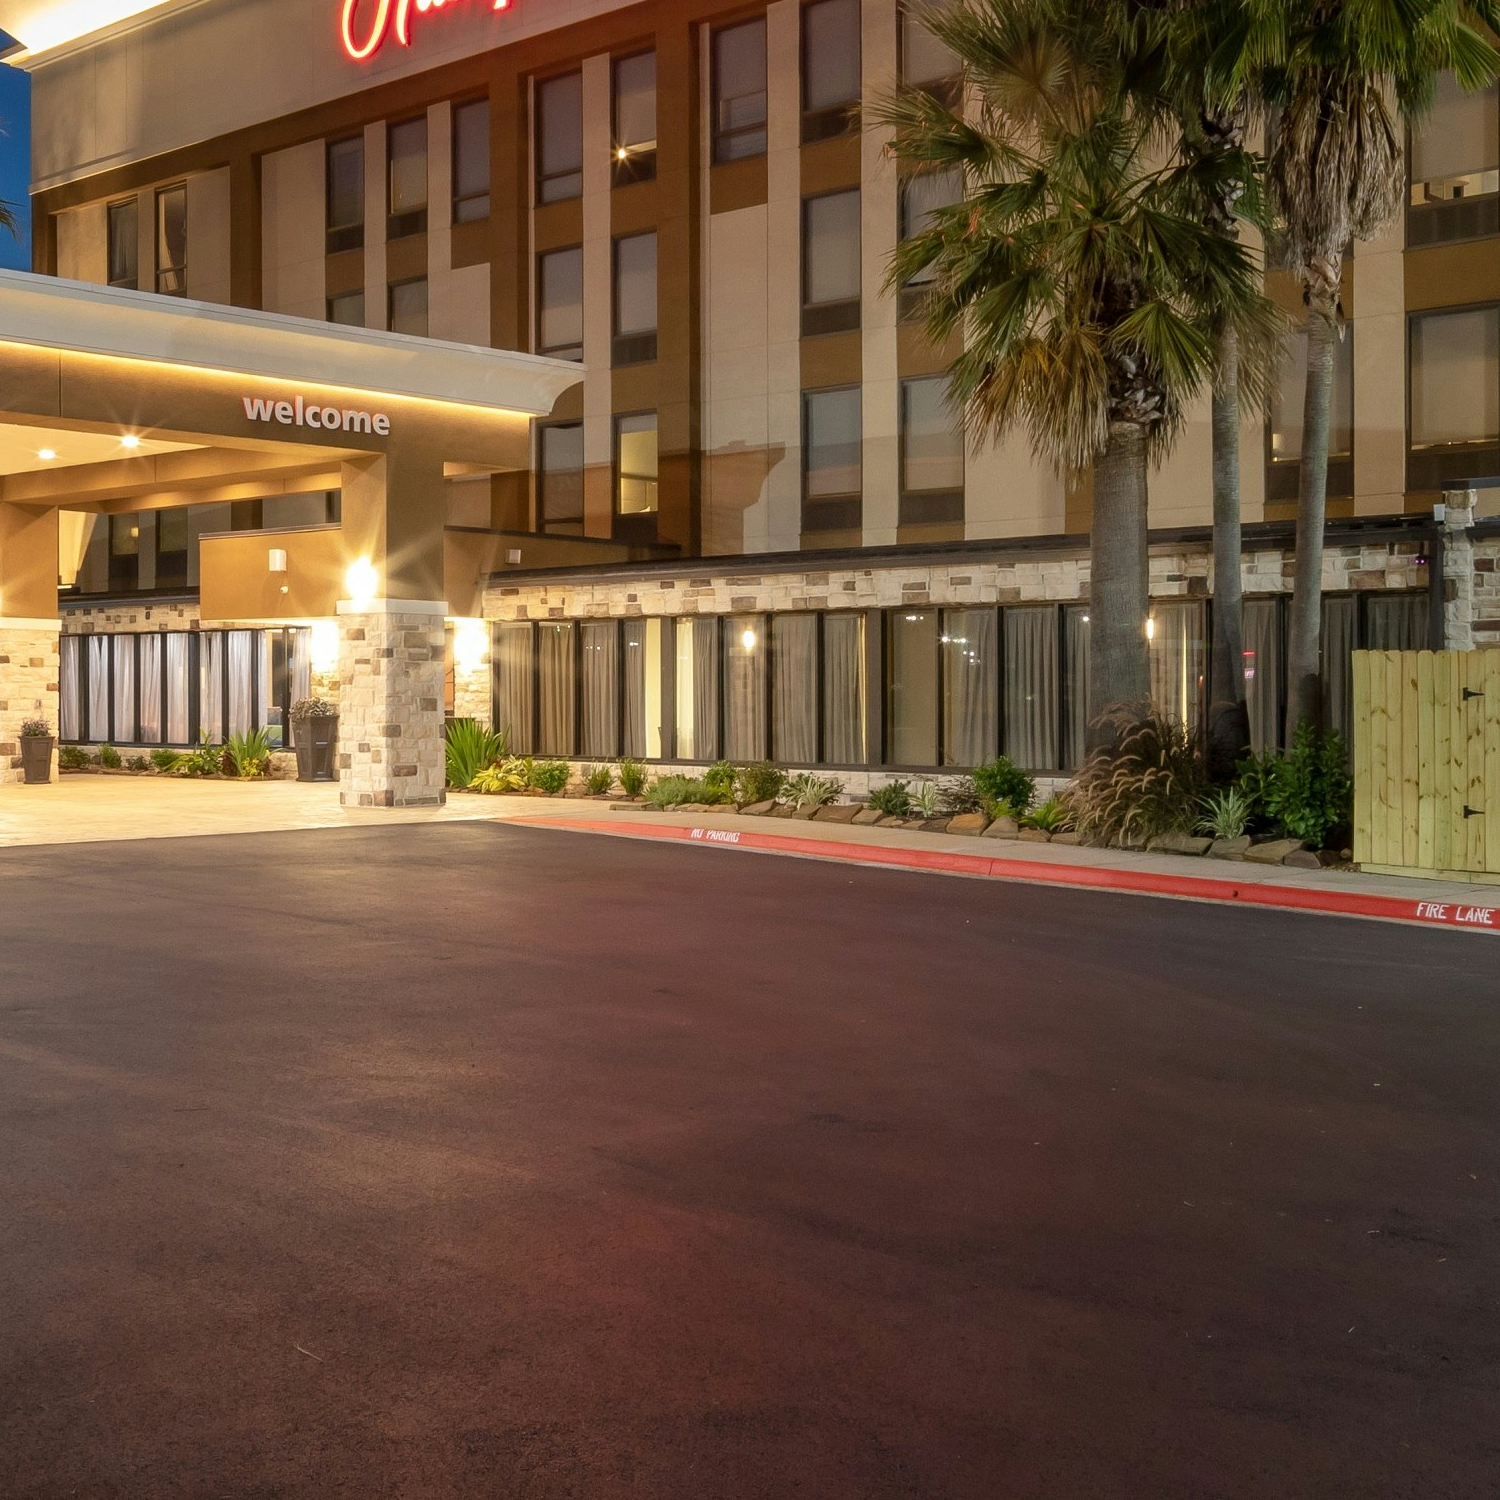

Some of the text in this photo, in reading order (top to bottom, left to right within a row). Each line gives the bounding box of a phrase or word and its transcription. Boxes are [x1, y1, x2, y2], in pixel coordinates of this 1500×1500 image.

[242, 395, 391, 436] welcome
[1416, 902, 1496, 924] FIRE LANE
